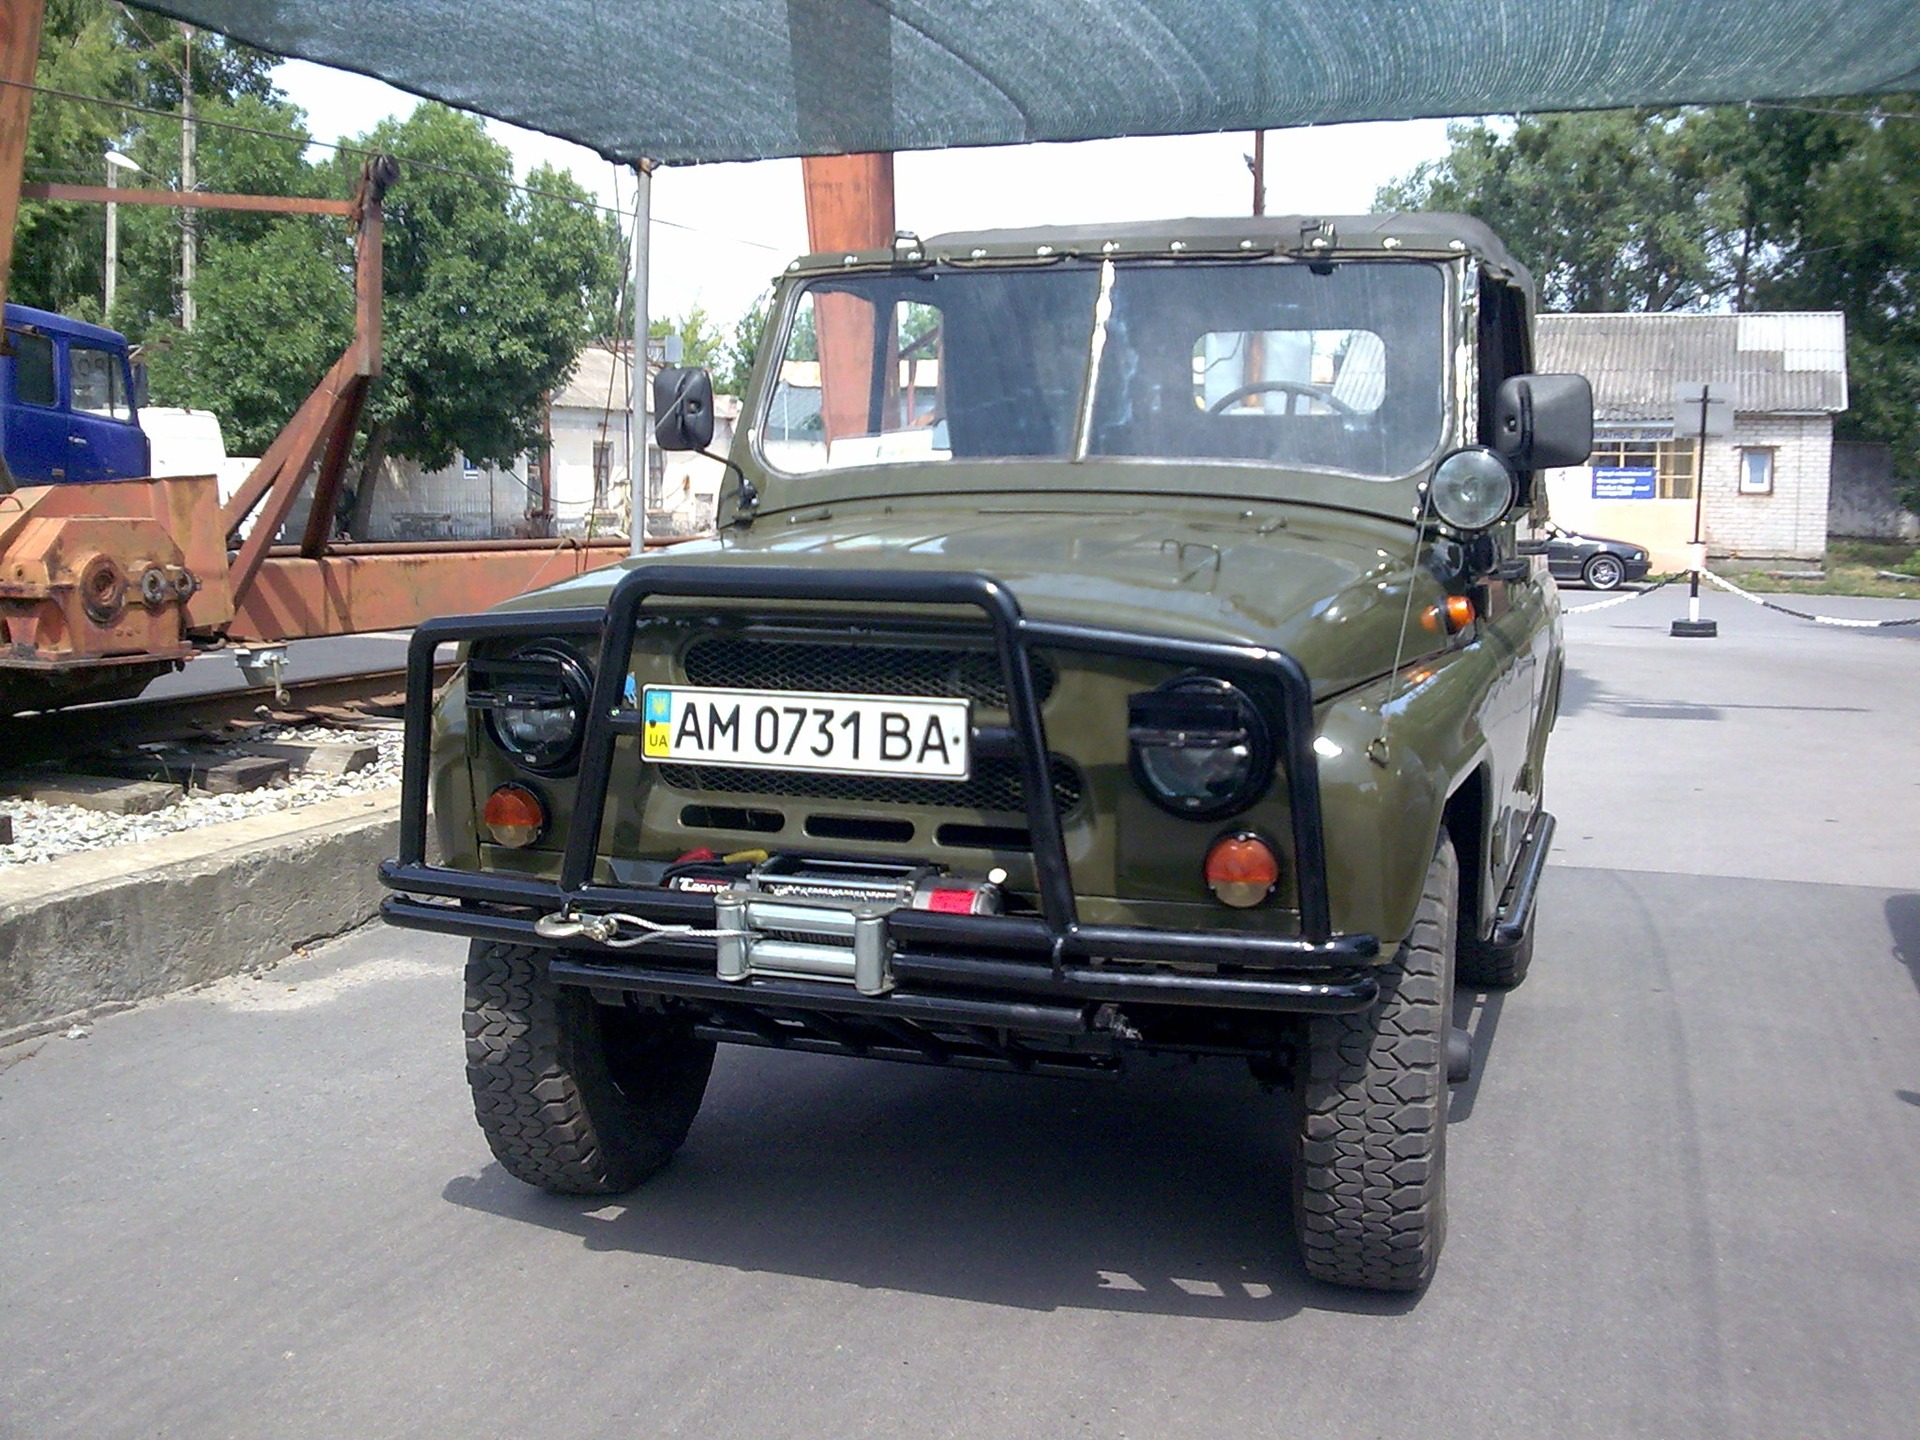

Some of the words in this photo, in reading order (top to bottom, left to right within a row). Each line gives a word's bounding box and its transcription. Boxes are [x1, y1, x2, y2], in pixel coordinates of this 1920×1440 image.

[1594, 429, 1634, 440] НАТНЫЕ
[674, 702, 741, 752] AM
[755, 705, 860, 760] 0731
[880, 711, 950, 765] BA
[649, 734, 668, 748] UA
